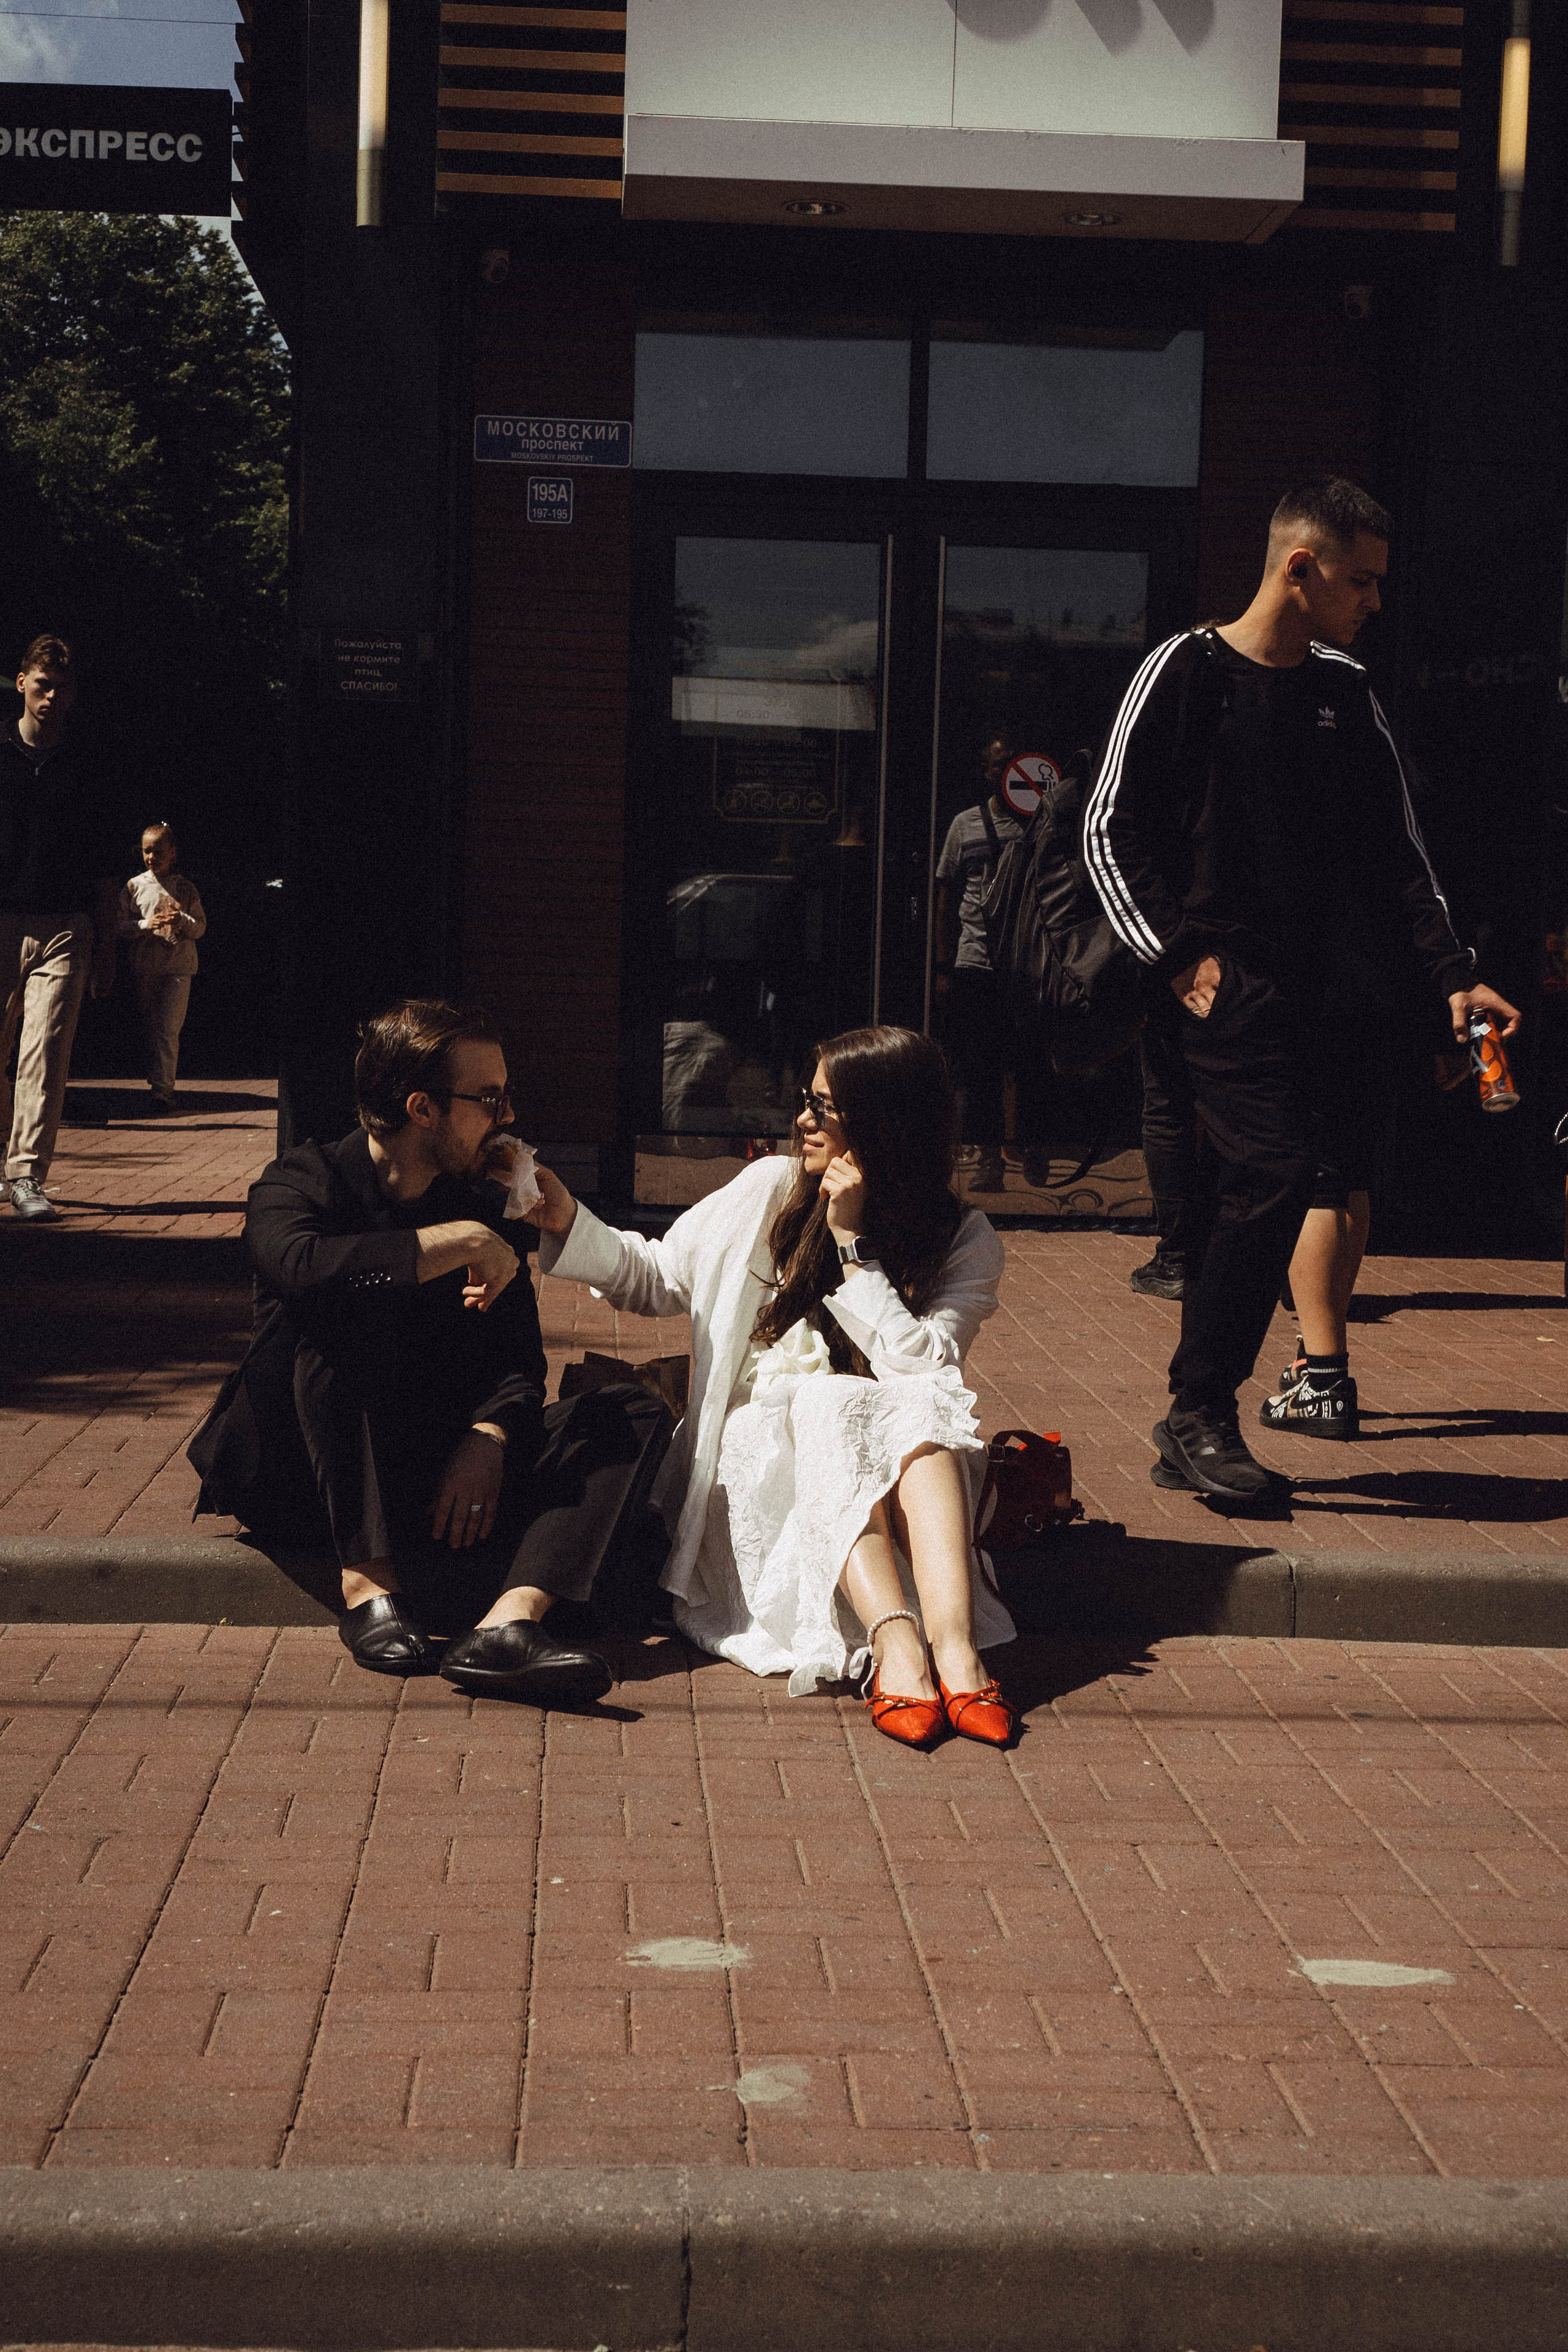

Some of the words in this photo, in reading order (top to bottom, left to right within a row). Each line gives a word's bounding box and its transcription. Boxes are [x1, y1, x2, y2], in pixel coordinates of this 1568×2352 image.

[488, 420, 619, 440] МОСКОВСКИЙ
[521, 439, 584, 452] проспект
[511, 452, 556, 461] MOSKOVSKIY
[557, 454, 594, 462] PROSPEKT
[532, 483, 568, 502] 195А
[532, 508, 568, 520] 197-195
[334, 638, 402, 650] Пожалуйста
[353, 655, 401, 665] кормите
[341, 680, 398, 692] СПАСИБО!
